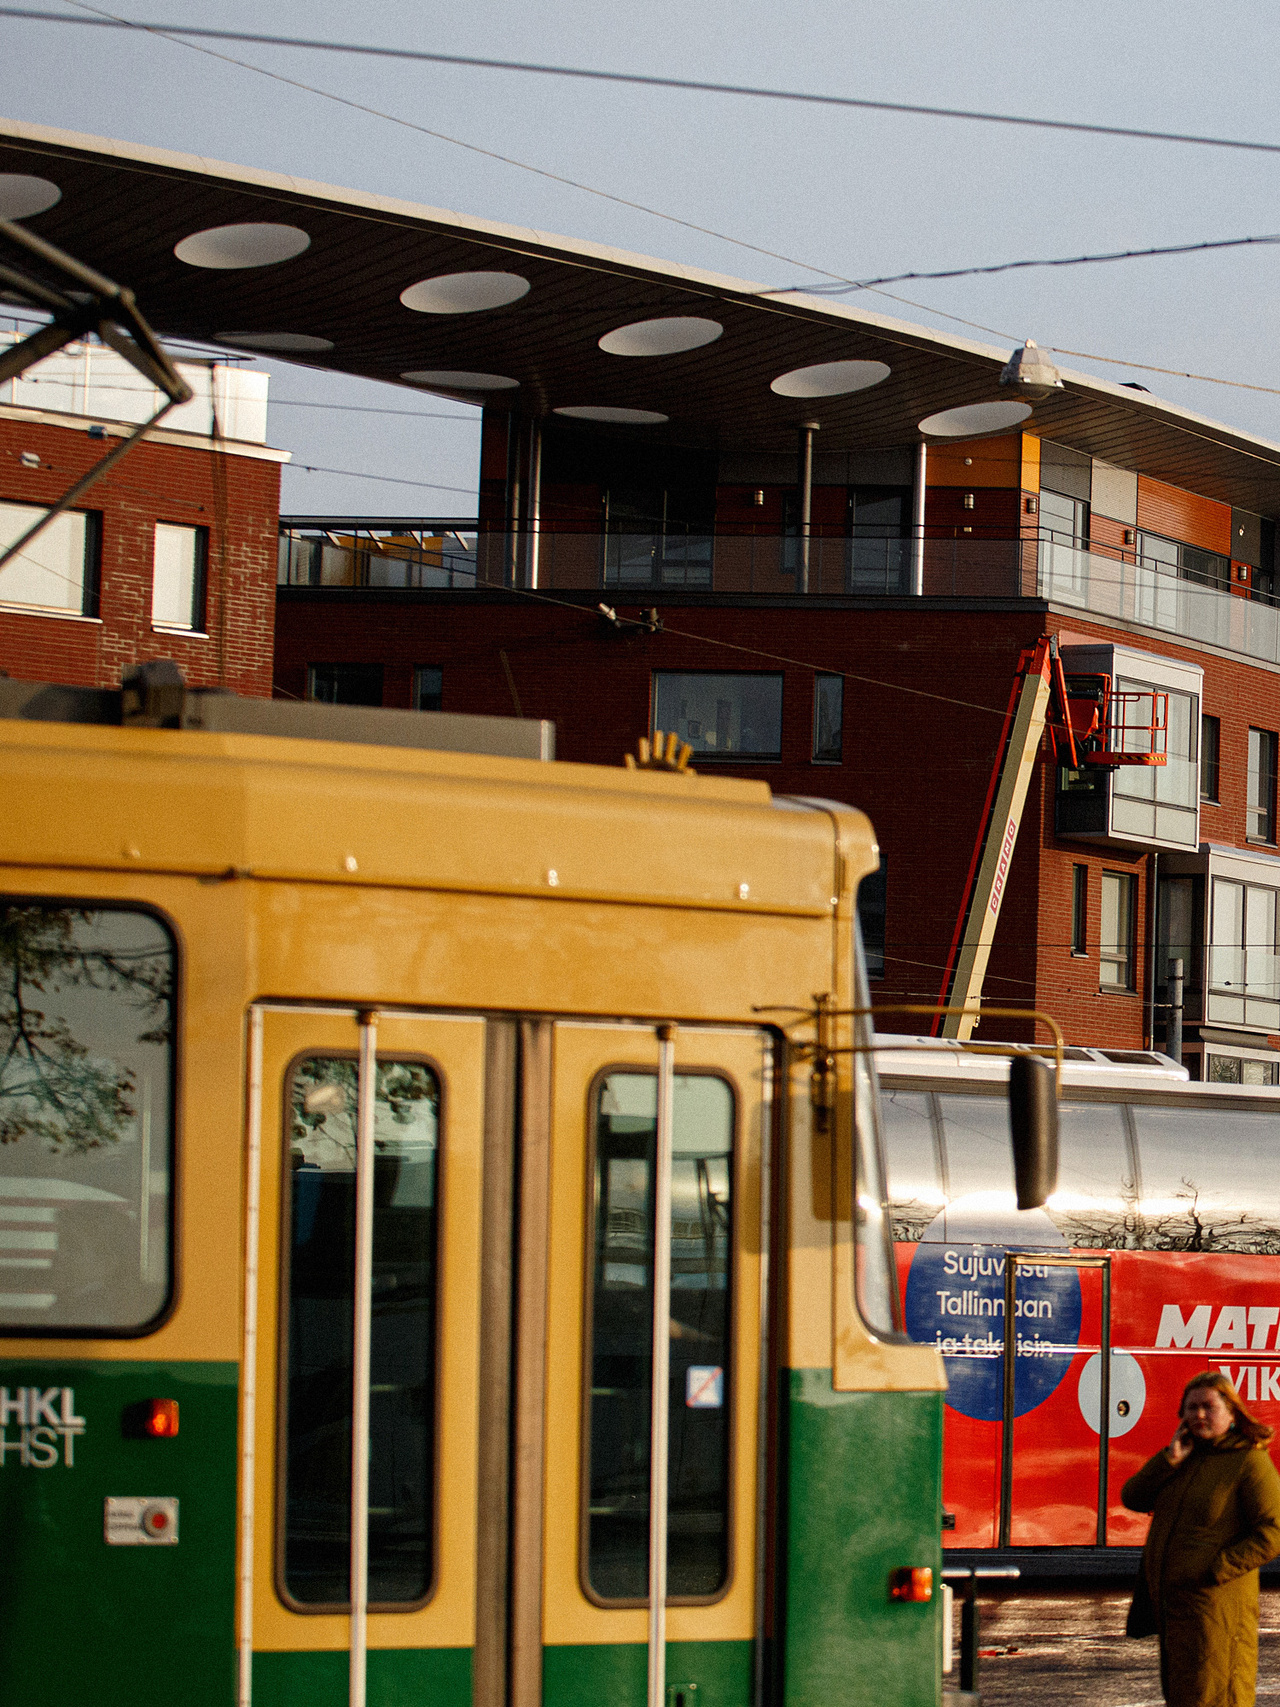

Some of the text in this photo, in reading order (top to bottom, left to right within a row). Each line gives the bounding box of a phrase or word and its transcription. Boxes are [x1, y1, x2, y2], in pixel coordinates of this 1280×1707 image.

[991, 824, 1015, 907] GRANO
[962, 1331, 1053, 1357] takisin
[0, 1386, 86, 1427] HKL
[0, 1426, 86, 1468] HST
